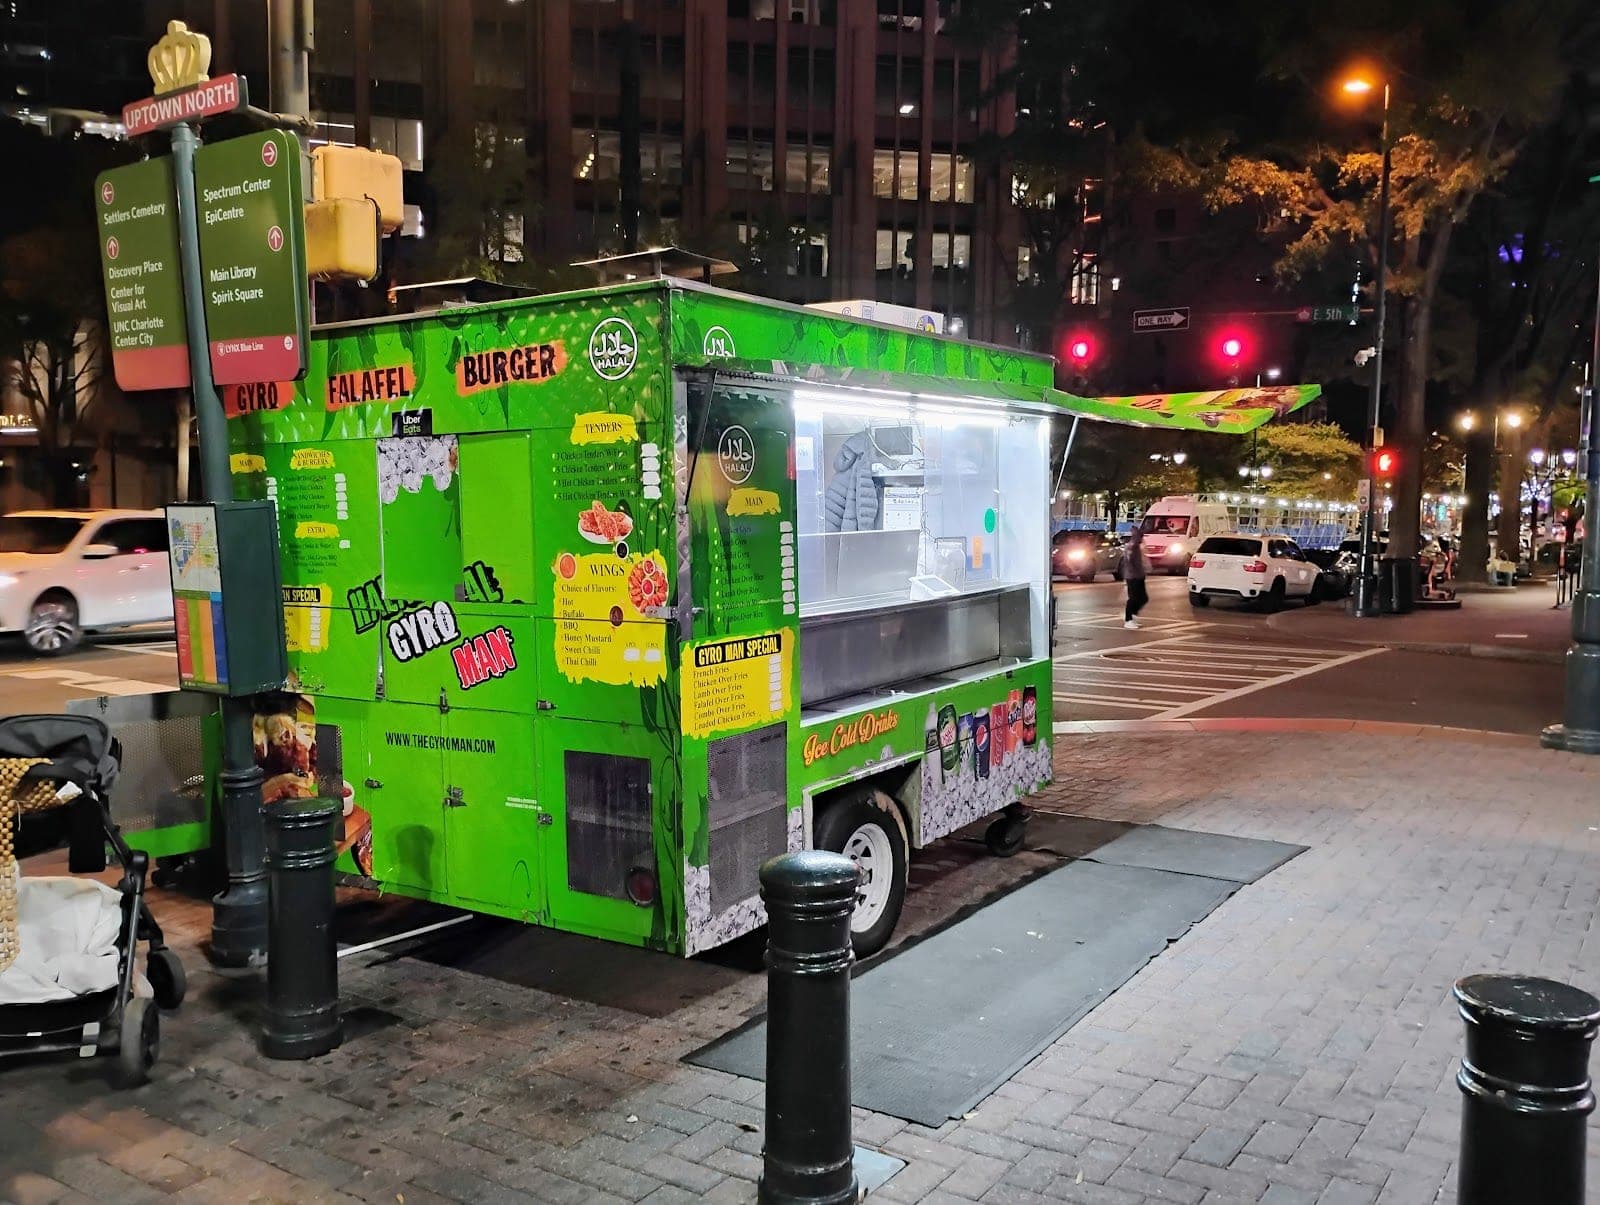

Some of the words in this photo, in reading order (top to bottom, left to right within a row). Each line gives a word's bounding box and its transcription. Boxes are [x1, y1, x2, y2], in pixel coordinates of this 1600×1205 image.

[125, 96, 182, 130] UPTOWN
[185, 82, 235, 113] NORTH
[203, 184, 242, 204] Spectrum
[243, 178, 271, 194] Center
[103, 209, 131, 225] Settlers
[131, 203, 166, 218] Cemetery
[205, 206, 245, 226] EpiCentre
[109, 264, 143, 279] Discovery
[143, 261, 163, 273] Place
[210, 269, 229, 282] Main
[230, 266, 257, 280] Library
[110, 287, 133, 299] Center
[134, 283, 145, 295] for
[212, 289, 234, 306] Spirit
[235, 287, 264, 304] Square
[112, 300, 134, 313] Visual
[135, 299, 147, 310] Art
[1326, 307, 1342, 320] 5th
[113, 320, 131, 333] UNC
[131, 316, 164, 332] Charlotte
[1139, 317, 1155, 326] ONE
[115, 335, 138, 347] Center
[138, 332, 154, 346] City
[594, 329, 634, 357] حلال
[225, 343, 240, 354] LYNX
[240, 342, 252, 352] Blue
[252, 342, 264, 352] Line
[463, 343, 558, 388] BURGER
[597, 356, 632, 369] HALAL
[327, 366, 410, 404] FALAFEL
[237, 381, 280, 411] GYRO
[402, 415, 421, 424] Uber
[402, 424, 421, 434] Eats
[584, 421, 622, 434] TENDERS
[722, 438, 753, 462] حلال
[725, 463, 750, 473] HALAL
[745, 496, 764, 506] MAIN
[307, 526, 326, 534] EXTRA
[590, 563, 625, 577] WINGS
[292, 589, 319, 602] SPECIAL
[561, 584, 582, 593] Choice
[583, 584, 590, 592] of
[591, 584, 617, 593] Flavors:
[562, 597, 574, 606] Hot
[562, 609, 585, 618] Buffalo
[387, 600, 460, 662] GYRO
[563, 621, 579, 631] BBQ
[564, 633, 583, 643] Honey
[584, 634, 612, 643] Mustard
[564, 645, 582, 654] Sweet
[582, 645, 601, 655] Chilli
[698, 646, 723, 666] GYRO
[725, 642, 745, 661] MAN
[747, 636, 779, 658] SPECIAL
[452, 626, 517, 690] MAN
[565, 657, 579, 665] Thai
[580, 657, 597, 666] Chilli
[693, 668, 714, 679] French
[715, 667, 729, 675] Fries
[693, 678, 717, 689] Chicken
[718, 675, 733, 683] Over
[734, 672, 749, 681] Fries
[693, 689, 711, 699] Lamb
[711, 686, 726, 695] Over
[728, 684, 742, 692] Fries
[694, 698, 714, 709] Falafel
[714, 697, 729, 705] Over
[730, 693, 745, 702] Fries
[716, 706, 731, 715] Over
[732, 703, 746, 712] Fries
[694, 719, 716, 730] Loaded
[717, 713, 741, 724] Chicken
[741, 710, 756, 719] Fries
[385, 731, 496, 754] WWW.THEGYROMAN.COM
[803, 733, 829, 769] Ice
[829, 723, 858, 755] Cold
[858, 709, 899, 744] Drinks
